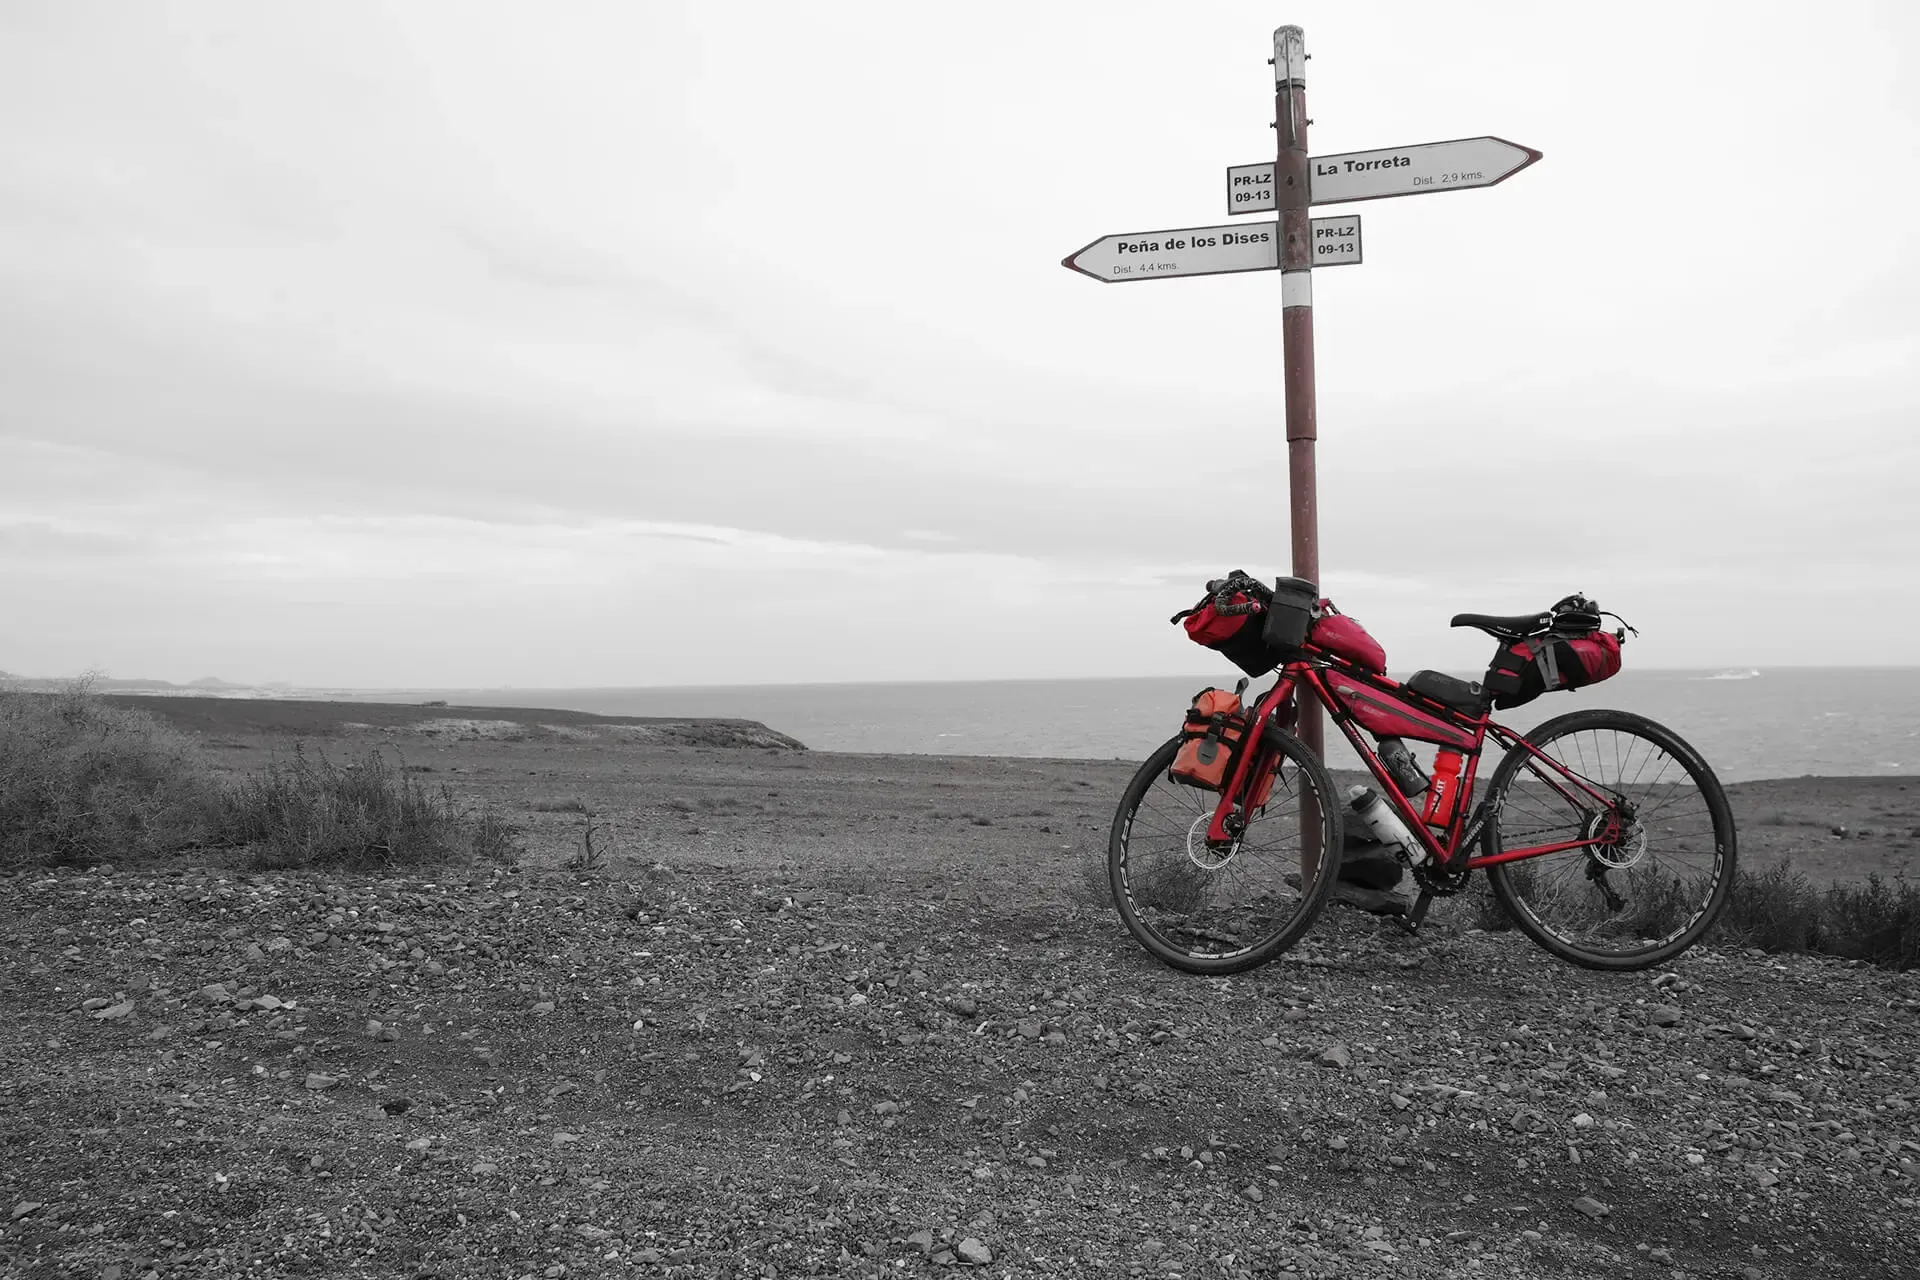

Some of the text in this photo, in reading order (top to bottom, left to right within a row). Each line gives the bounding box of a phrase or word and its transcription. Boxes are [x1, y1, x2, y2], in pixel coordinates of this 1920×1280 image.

[1317, 155, 1411, 176] La Torreta
[1234, 174, 1272, 186] PR-LZ
[1413, 176, 1436, 186] Dist.
[1461, 171, 1486, 181] kms.
[1235, 190, 1271, 203] 09-13
[1316, 227, 1355, 239] PR-LZ
[1118, 232, 1269, 254] Peña de los Dises
[1318, 243, 1354, 255] 09-13
